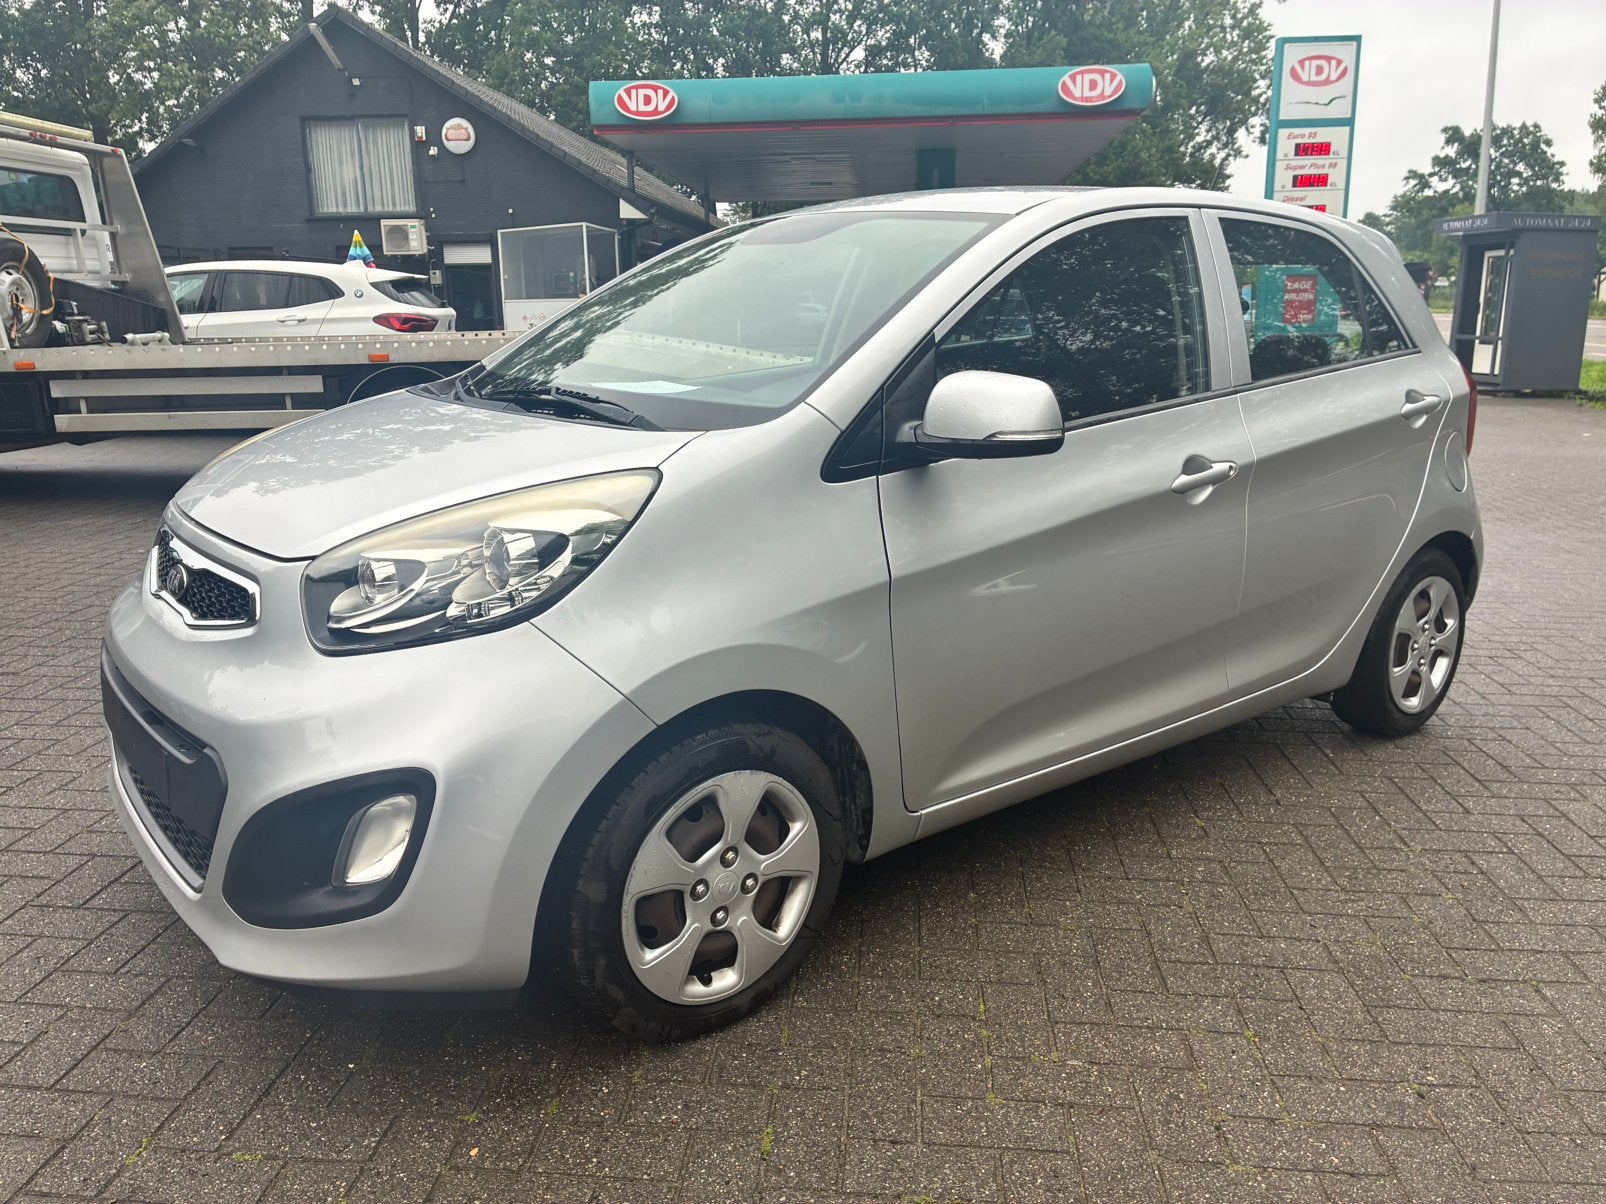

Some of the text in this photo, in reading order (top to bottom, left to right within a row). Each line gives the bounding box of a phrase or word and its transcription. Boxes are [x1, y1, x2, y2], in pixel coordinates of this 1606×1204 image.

[1294, 59, 1347, 82] VDV
[1064, 72, 1122, 97] VDV
[619, 88, 675, 112] VDV
[1286, 131, 1318, 140] Euro 95
[1284, 163, 1307, 172] Super
[1308, 162, 1326, 170] Plus
[1282, 195, 1307, 203] Diesel
[1513, 218, 1565, 227] AUTOMAAT
